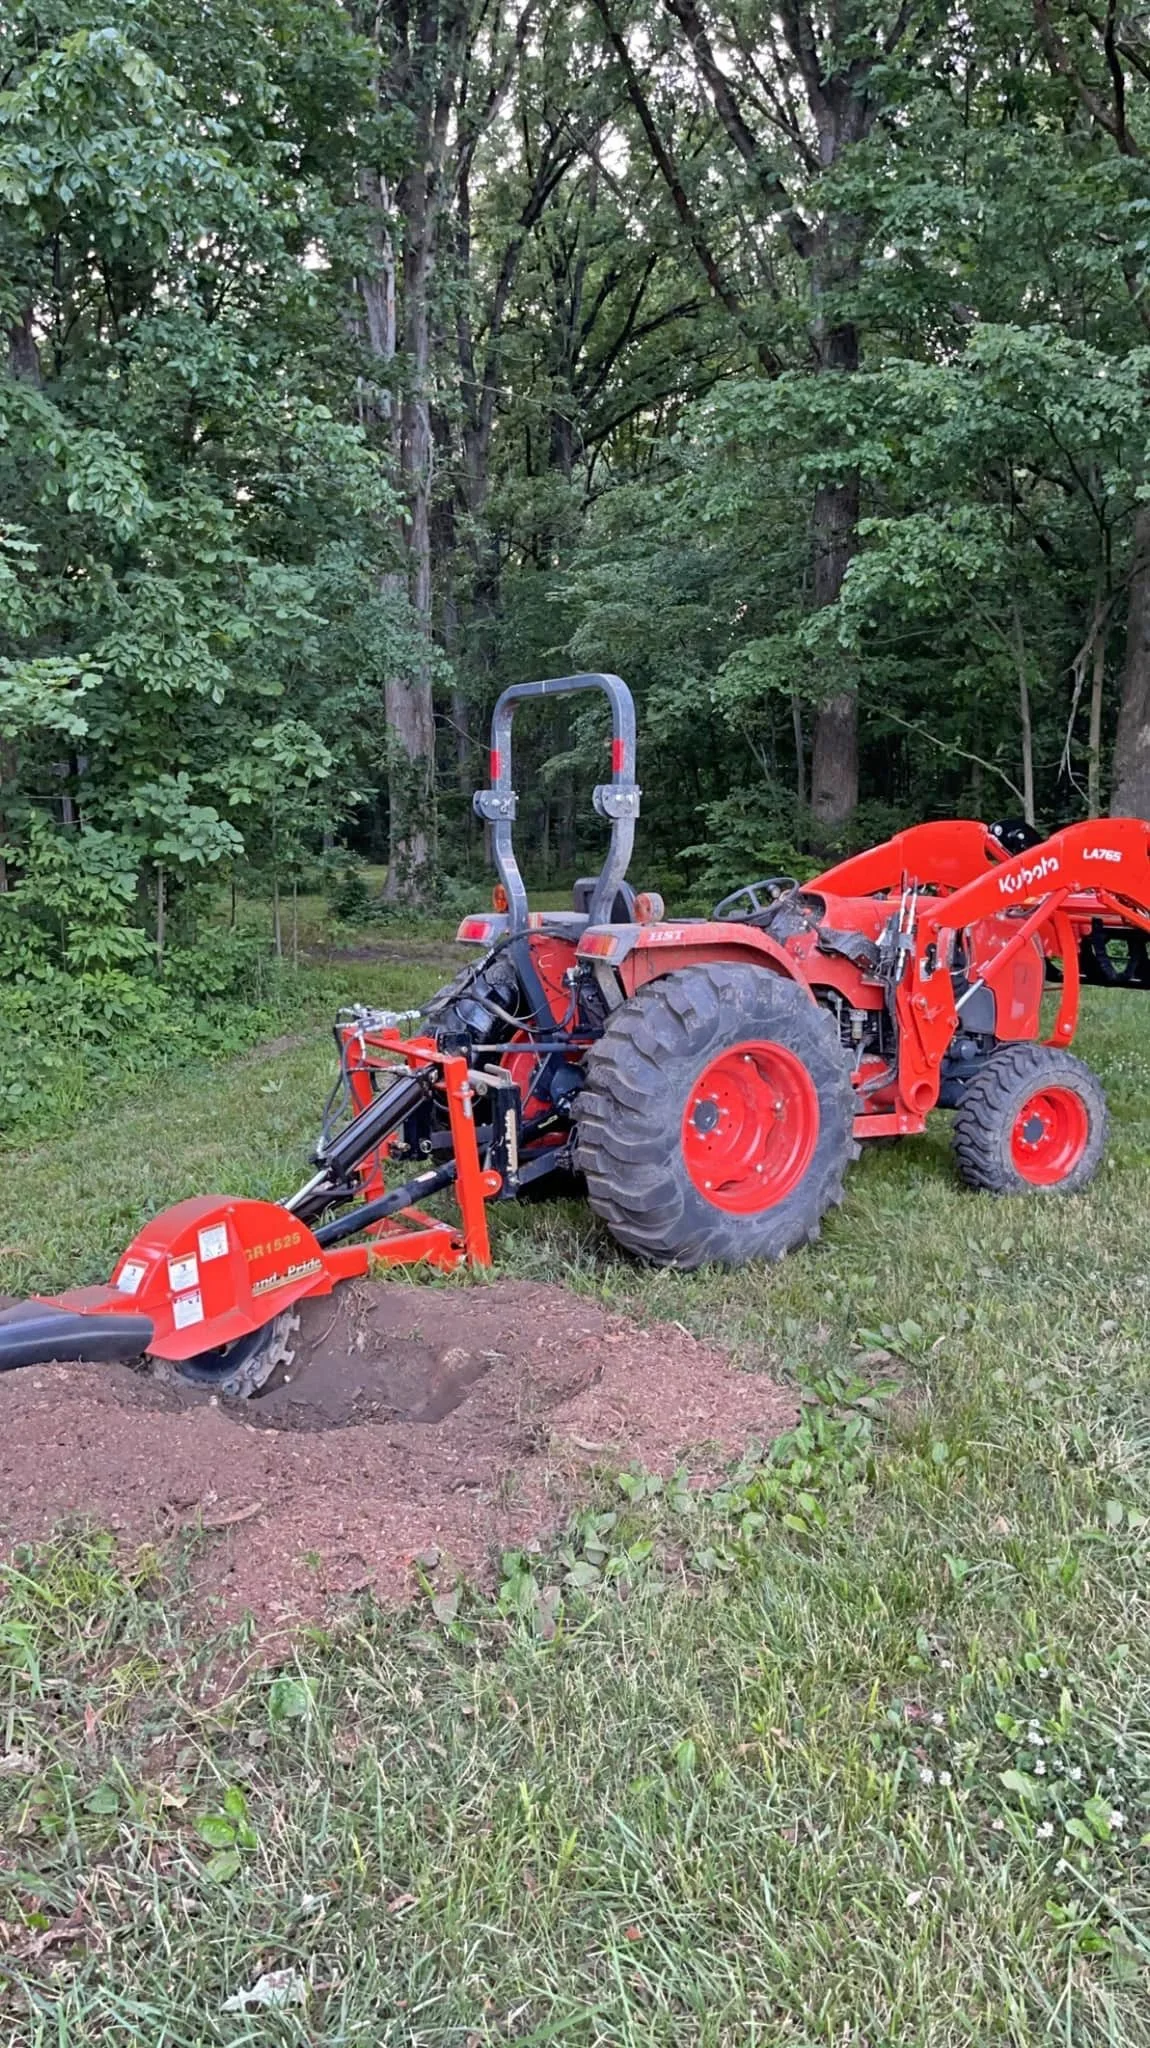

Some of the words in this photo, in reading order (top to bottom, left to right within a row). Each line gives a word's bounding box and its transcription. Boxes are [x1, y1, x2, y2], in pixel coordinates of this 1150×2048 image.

[1083, 848, 1122, 862] LA765
[999, 857, 1059, 893] Kubota
[251, 1272, 279, 1292] and
[287, 1257, 322, 1276] Pride
